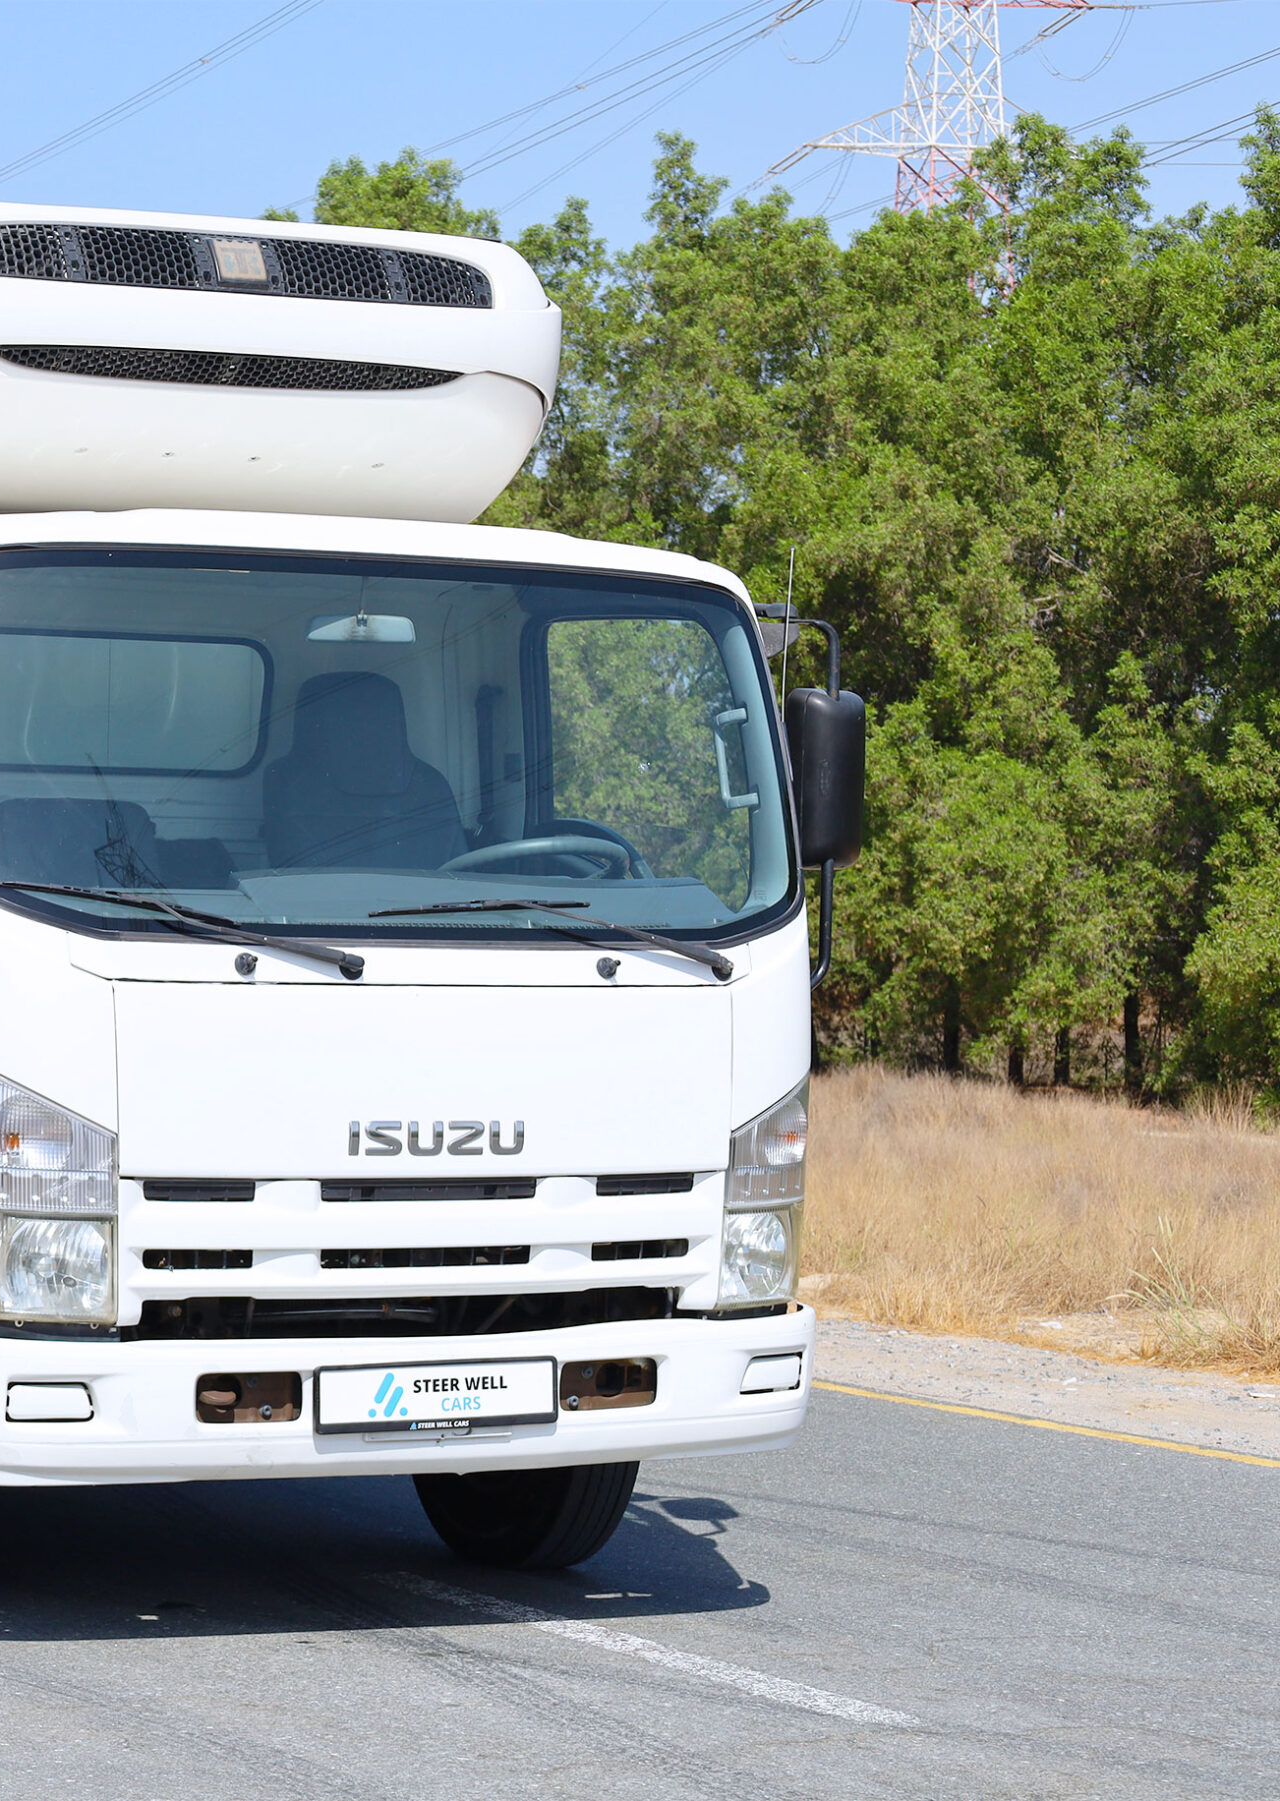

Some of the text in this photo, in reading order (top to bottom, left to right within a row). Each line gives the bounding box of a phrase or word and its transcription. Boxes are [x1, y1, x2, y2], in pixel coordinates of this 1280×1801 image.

[348, 1120, 524, 1156] ISUZU
[413, 1375, 508, 1393] STEER WELL
[441, 1396, 482, 1412] CARS
[453, 1420, 470, 1428] CARS
